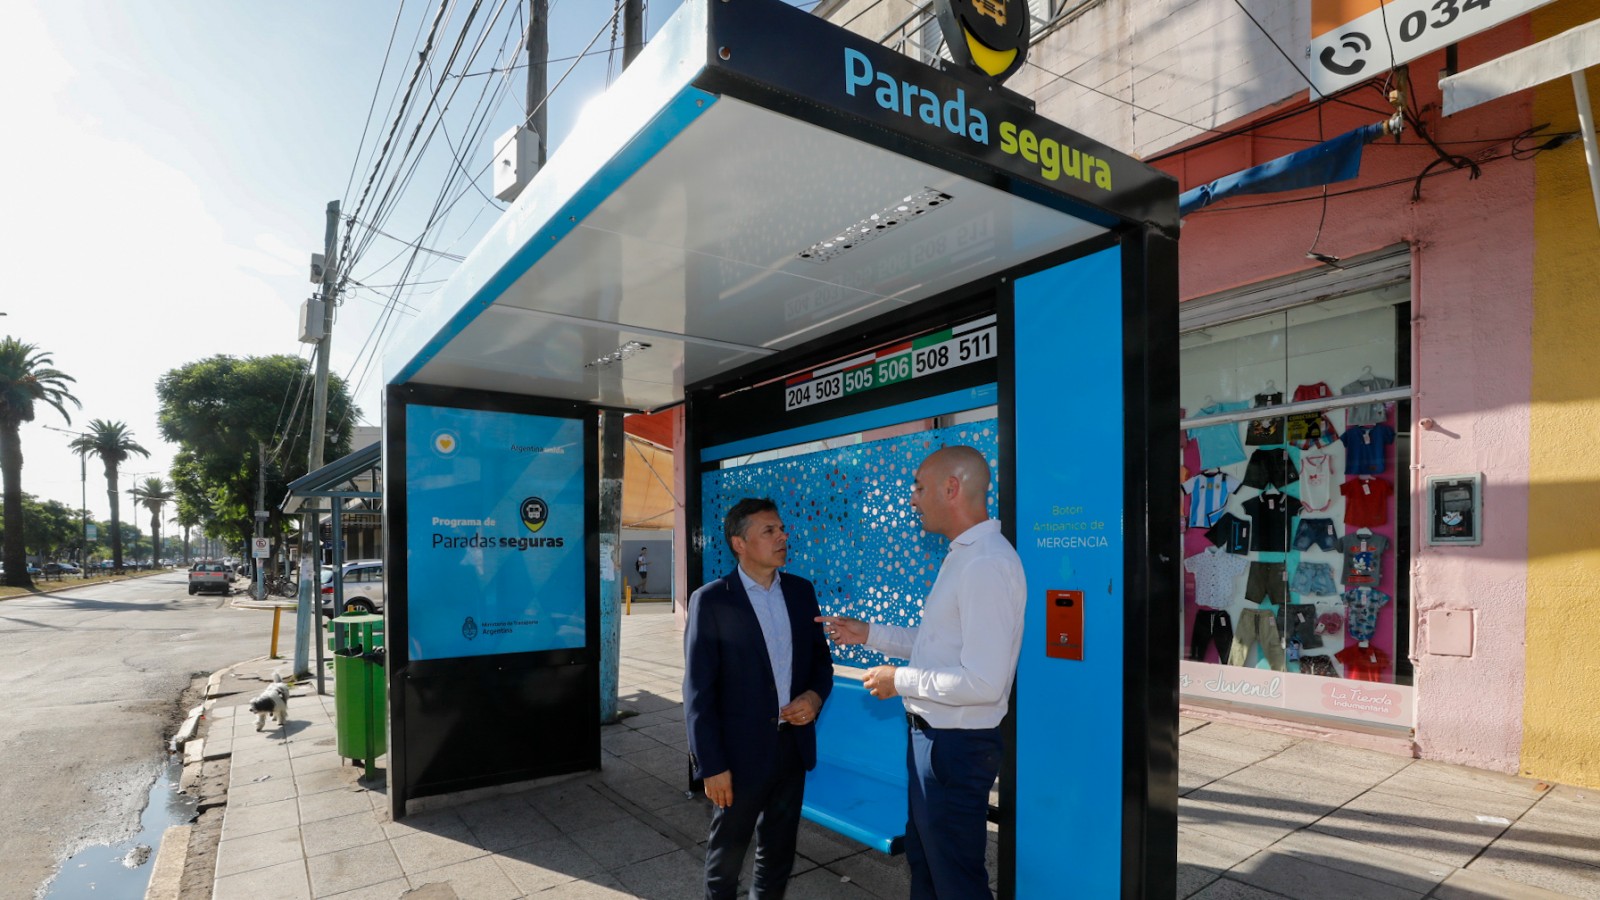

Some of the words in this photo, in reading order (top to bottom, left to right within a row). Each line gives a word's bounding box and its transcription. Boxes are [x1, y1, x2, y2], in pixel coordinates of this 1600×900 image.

[844, 47, 989, 146] Parada
[999, 121, 1112, 191] segura
[787, 385, 811, 408] 204
[815, 377, 841, 400] 503
[845, 367, 873, 392] 505
[878, 357, 909, 383] 506
[916, 345, 949, 373] 508
[959, 332, 991, 361] 511
[432, 517, 482, 528] Programa
[484, 517, 496, 527] de
[1090, 520, 1105, 530] de
[432, 533, 496, 549] Paradas
[499, 537, 564, 551] seguras
[1037, 536, 1109, 548] MERGENCIA
[1205, 669, 1281, 699] Juvenil
[1331, 687, 1347, 700] La
[1349, 688, 1394, 706] Tienda
[1334, 700, 1389, 714] Indumentaria
